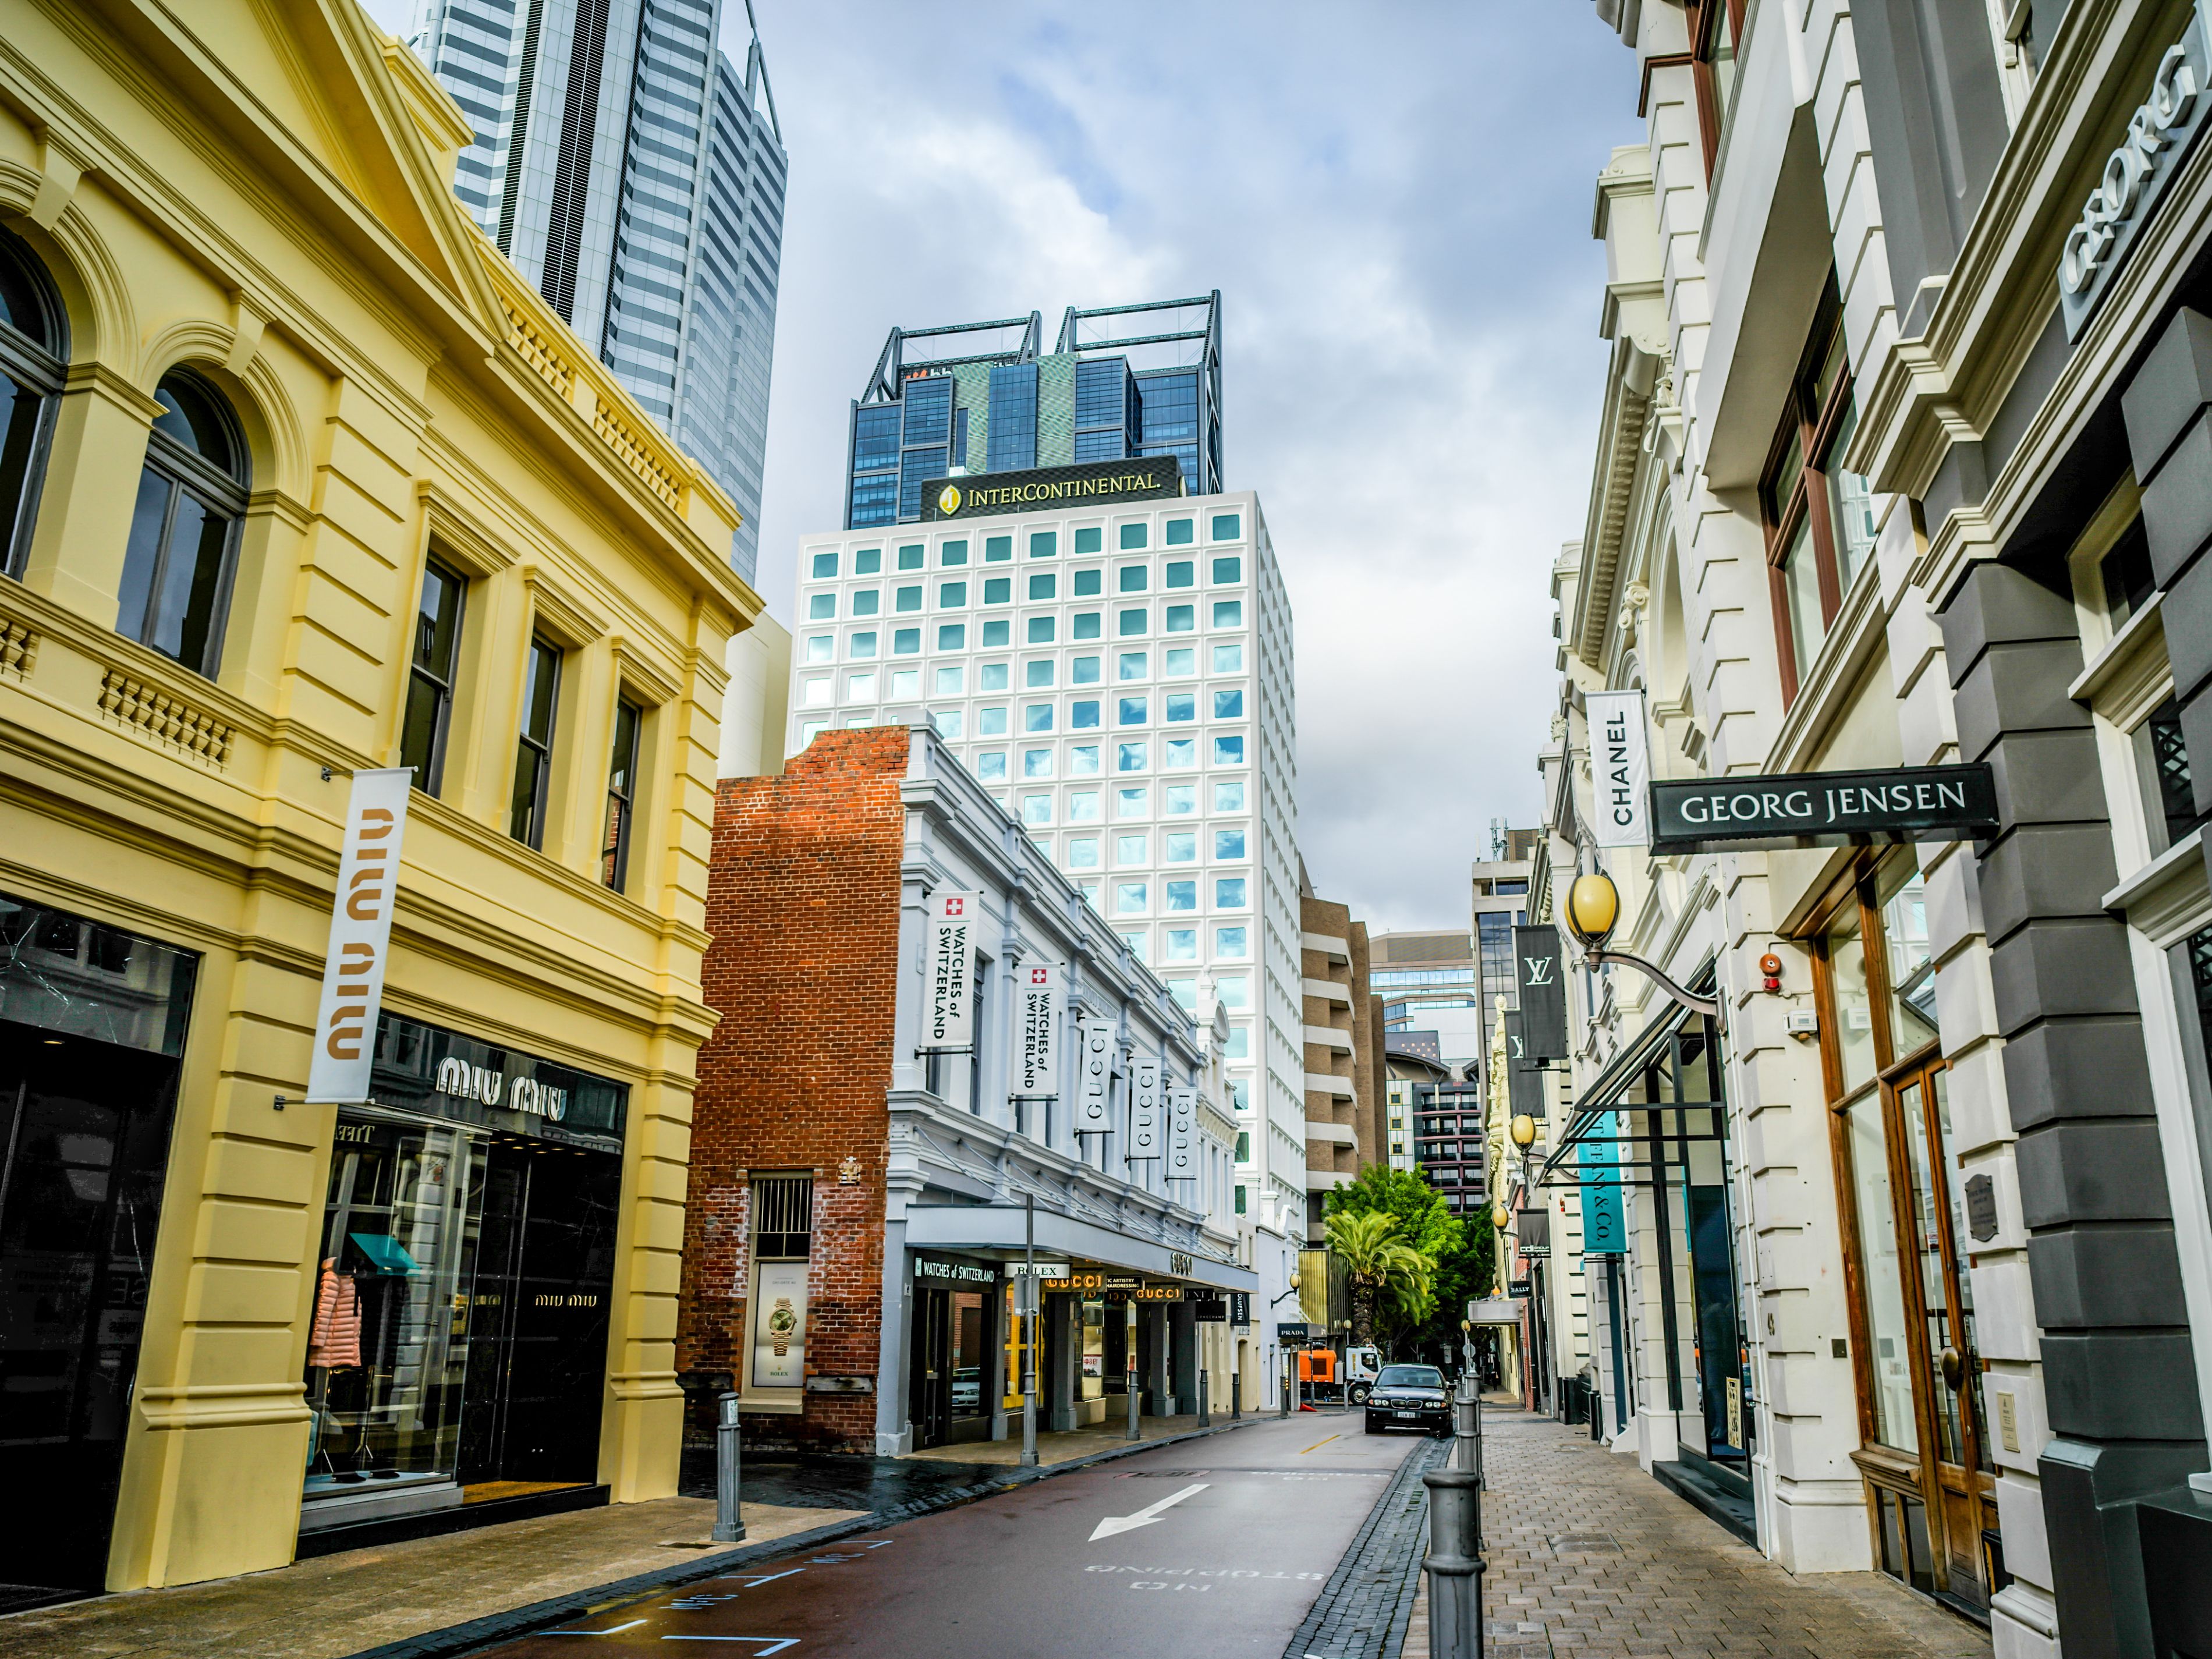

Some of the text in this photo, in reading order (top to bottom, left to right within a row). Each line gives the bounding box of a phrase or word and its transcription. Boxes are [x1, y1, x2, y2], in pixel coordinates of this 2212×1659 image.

[2062, 44, 2197, 295] GEORG
[1608, 711, 1633, 826] CHANEL
[1681, 782, 1966, 823] GEORG JENSEN
[933, 927, 951, 1040] SWITZERLAND
[949, 926, 966, 1018] WATCHES of
[1024, 993, 1037, 1089] SWITZERLAND
[1037, 992, 1050, 1071] WATCHES of
[1087, 1027, 1107, 1119] GUCCI
[1137, 1066, 1154, 1147] GUCCI
[1175, 1094, 1190, 1167] GUCCI
[924, 1261, 994, 1283] WATCHES of SWITZERLAND
[1018, 1267, 1057, 1275] RLEX
[1136, 1289, 1179, 1299] GUCCI
